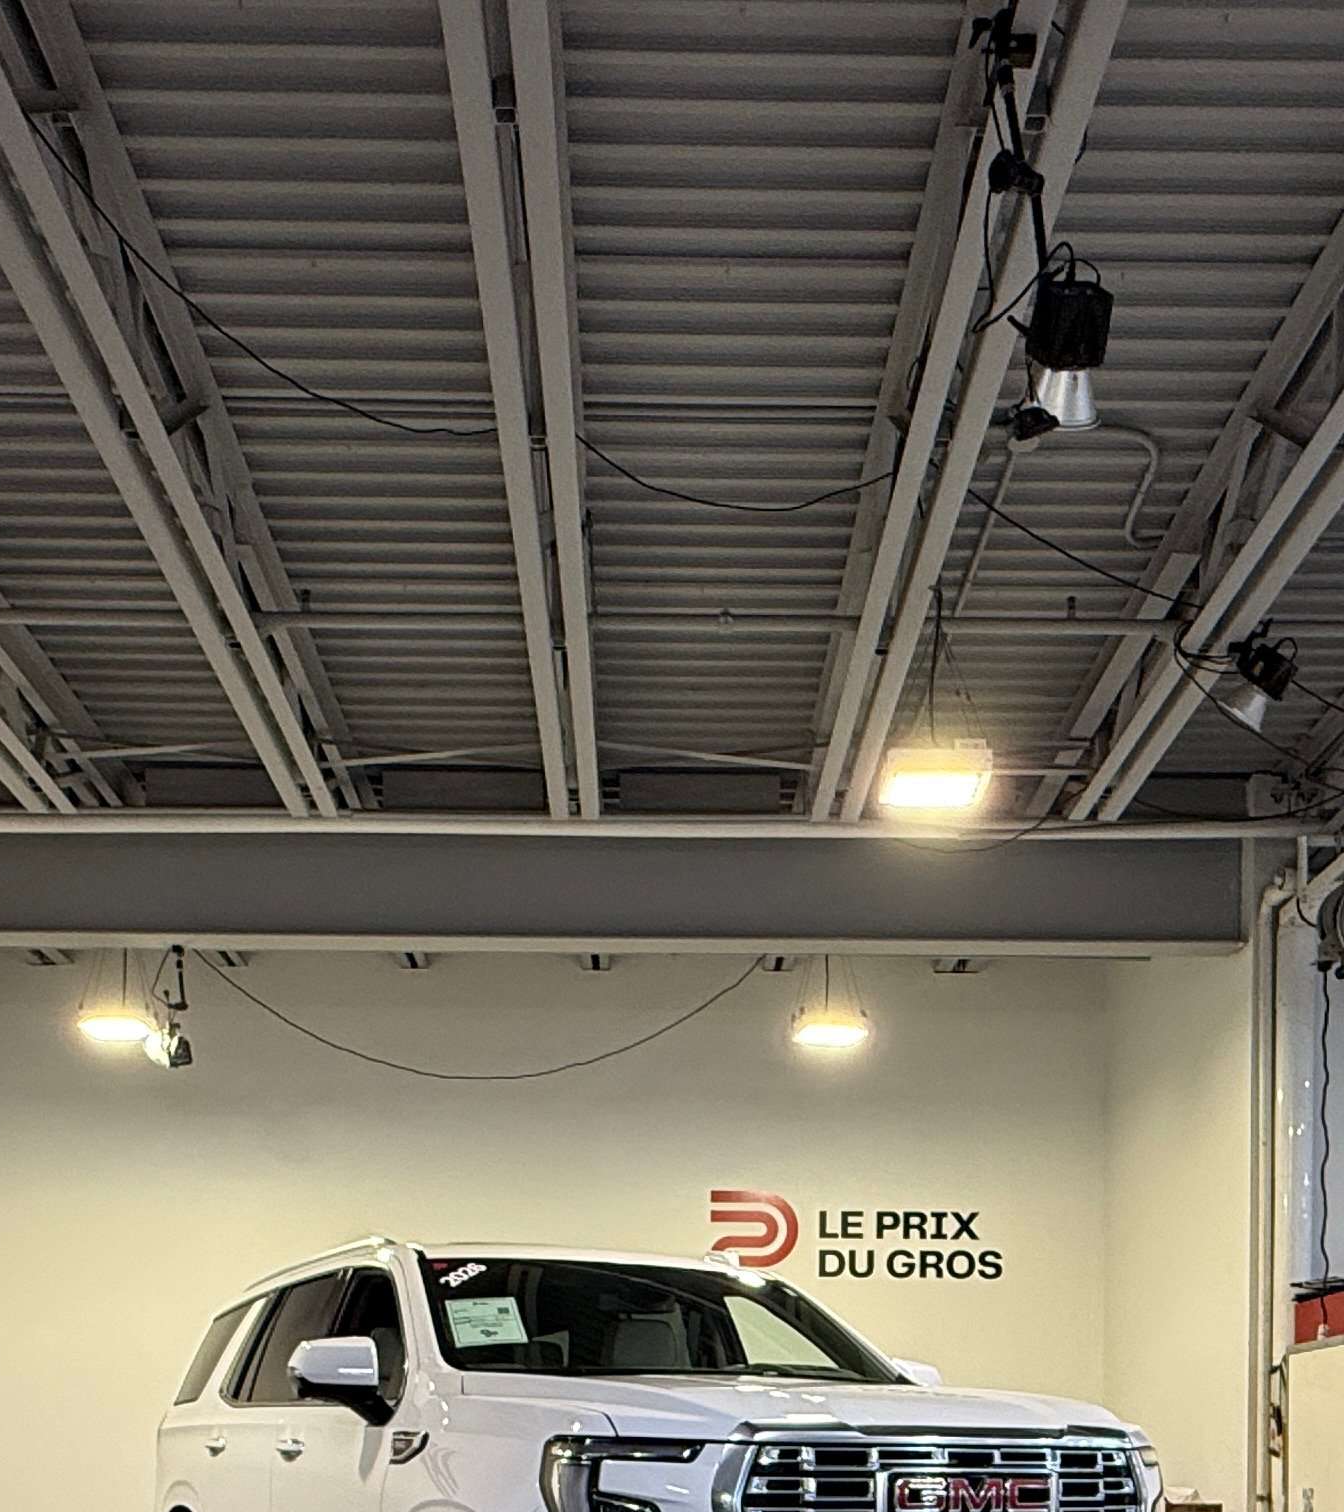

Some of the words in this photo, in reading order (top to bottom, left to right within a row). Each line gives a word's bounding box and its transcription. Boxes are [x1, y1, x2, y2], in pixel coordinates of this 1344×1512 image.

[818, 1211, 864, 1239] LE
[876, 1211, 979, 1240] PRIX
[818, 1249, 875, 1278] DU
[886, 1250, 1003, 1279] GROS
